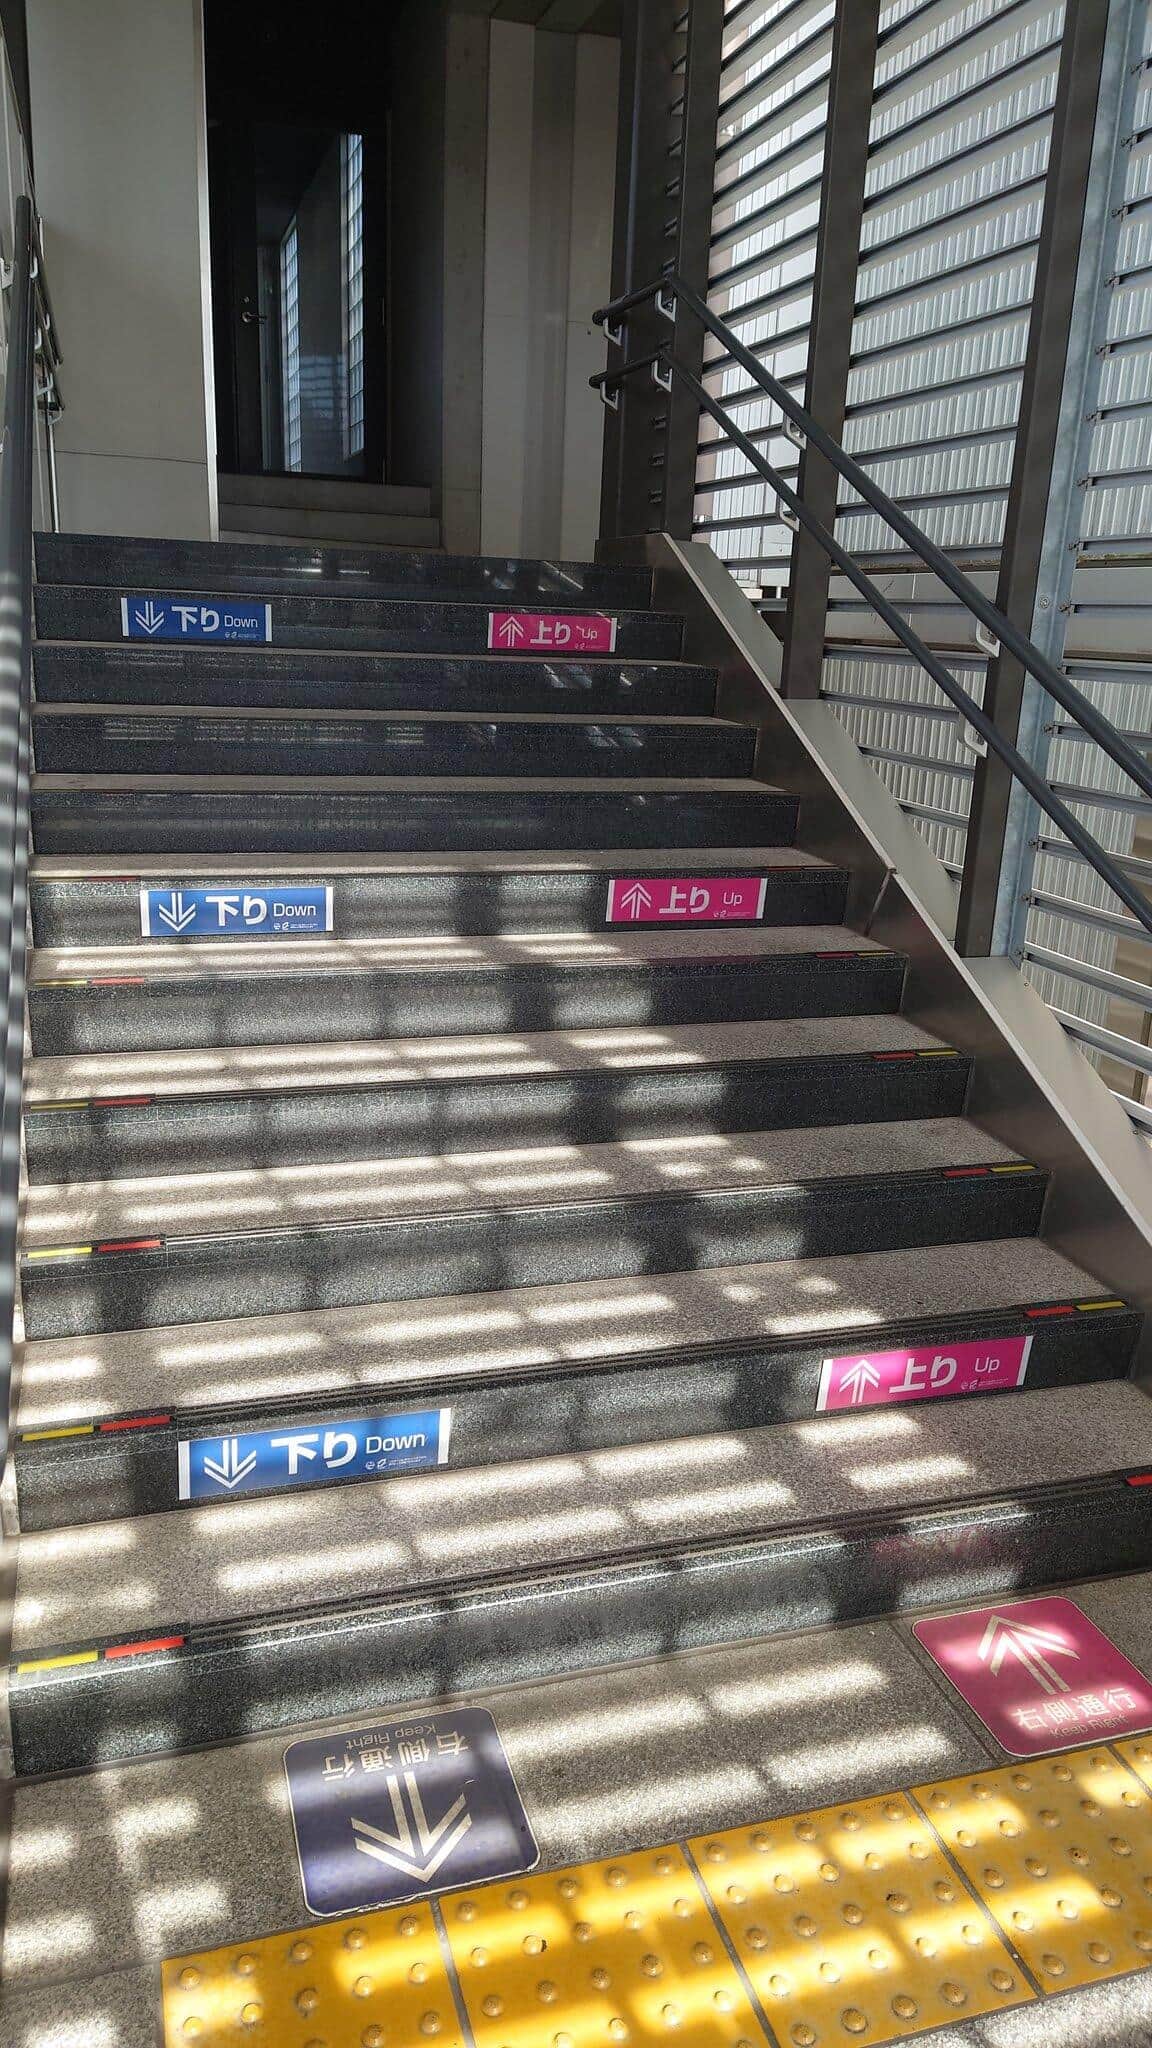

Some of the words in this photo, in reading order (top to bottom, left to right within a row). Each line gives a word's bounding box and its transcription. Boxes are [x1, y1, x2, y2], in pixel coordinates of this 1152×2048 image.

[171, 606, 220, 632] 下り
[224, 615, 258, 628] Down
[530, 620, 571, 644] 上り
[582, 628, 598, 640] Up
[205, 895, 267, 927] 下り
[273, 903, 316, 917] Down
[659, 886, 710, 914] 上り
[723, 892, 743, 906] Up
[889, 1356, 957, 1393] 上り
[974, 1357, 1000, 1373] Up
[270, 1431, 357, 1475] 下り
[366, 1433, 426, 1454] Down
[1012, 1687, 1136, 1730] 右側通行
[395, 1723, 436, 1738] Keep
[1050, 1723, 1089, 1738] Keep
[1089, 1714, 1129, 1729] Right
[346, 1732, 391, 1749] Right
[322, 1730, 469, 1782] 右側通行
